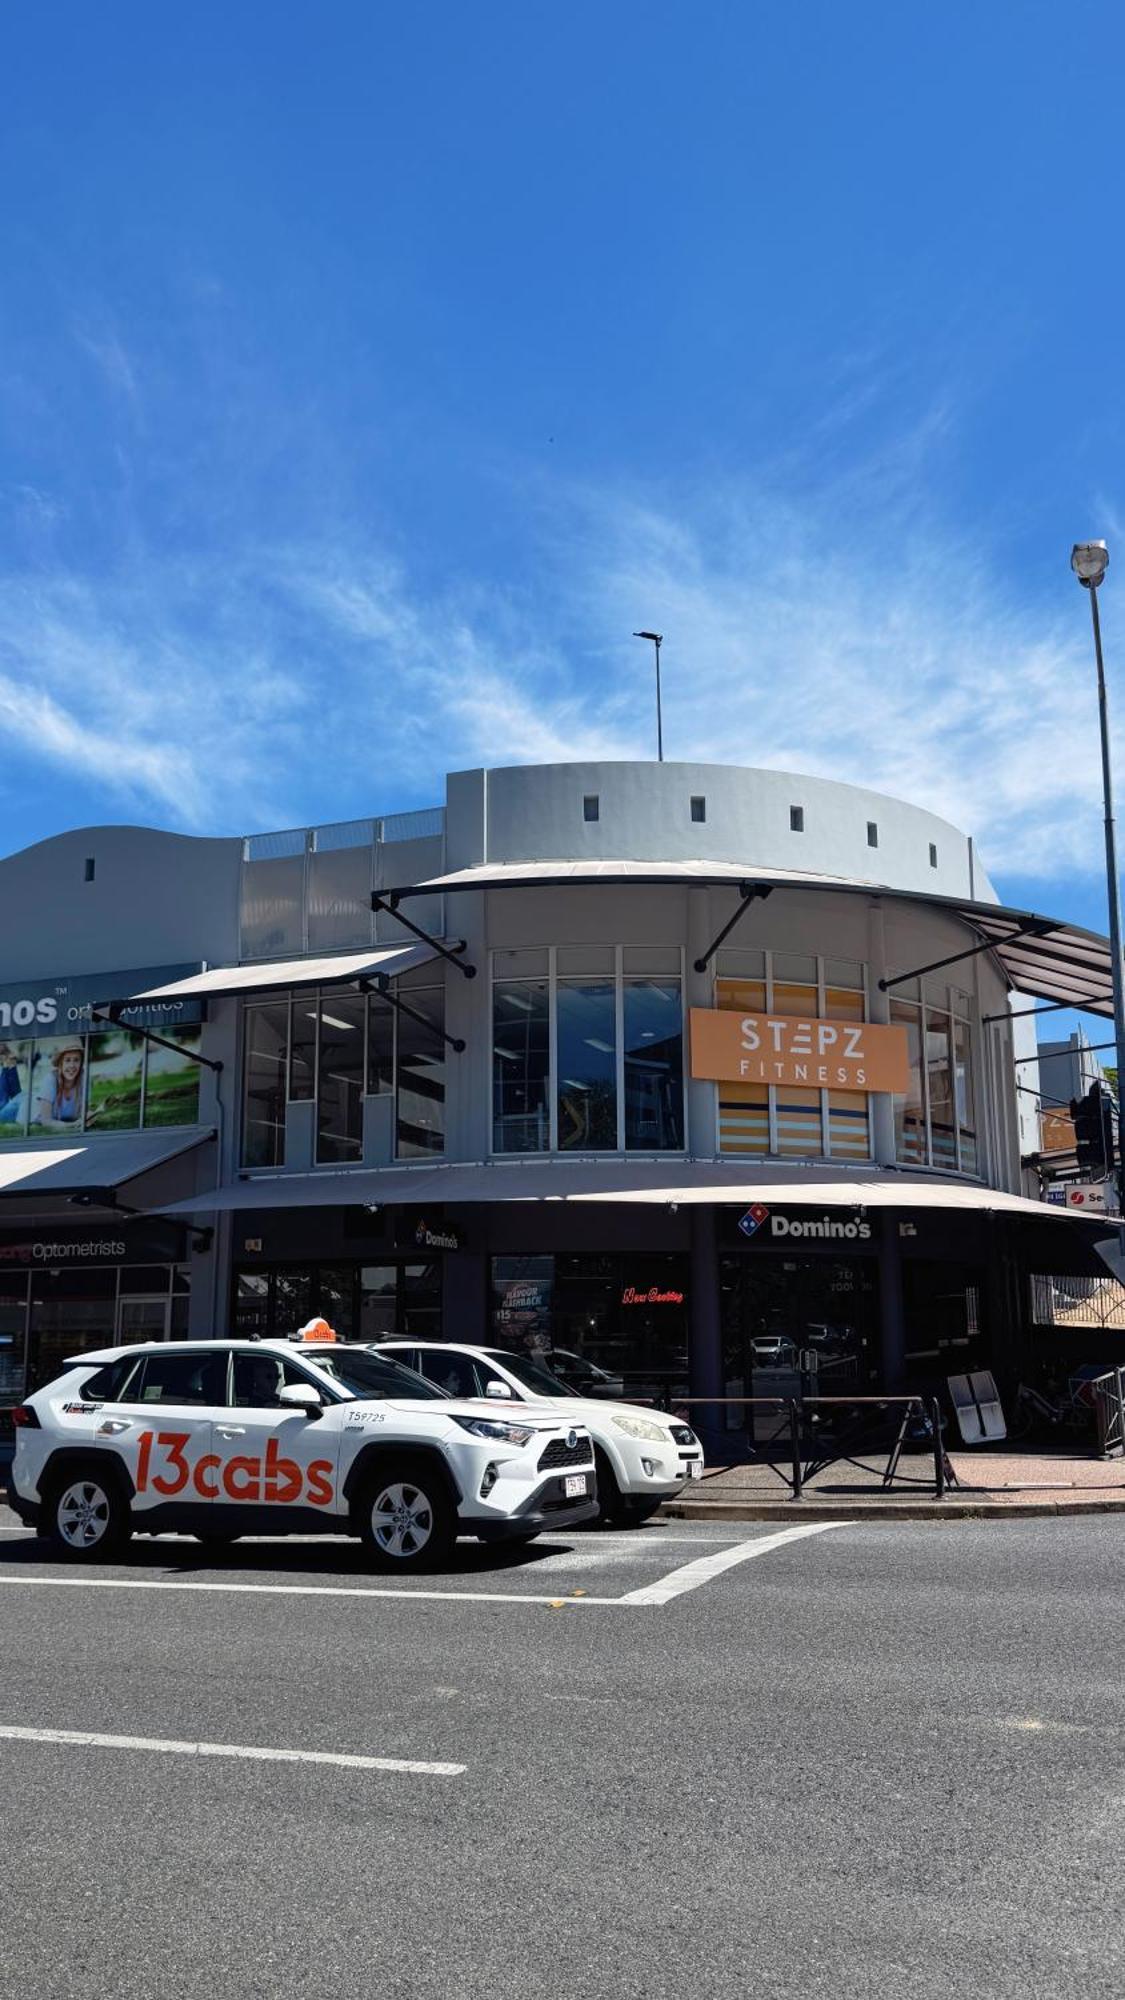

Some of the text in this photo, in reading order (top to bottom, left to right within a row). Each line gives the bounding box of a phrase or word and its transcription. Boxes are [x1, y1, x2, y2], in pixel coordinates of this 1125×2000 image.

[741, 1018, 865, 1058] STEPZ
[740, 1060, 866, 1084] FITNESS
[771, 1215, 872, 1239] Domino's
[32, 1240, 126, 1262] Optometrists
[136, 1431, 334, 1505] 13cabs
